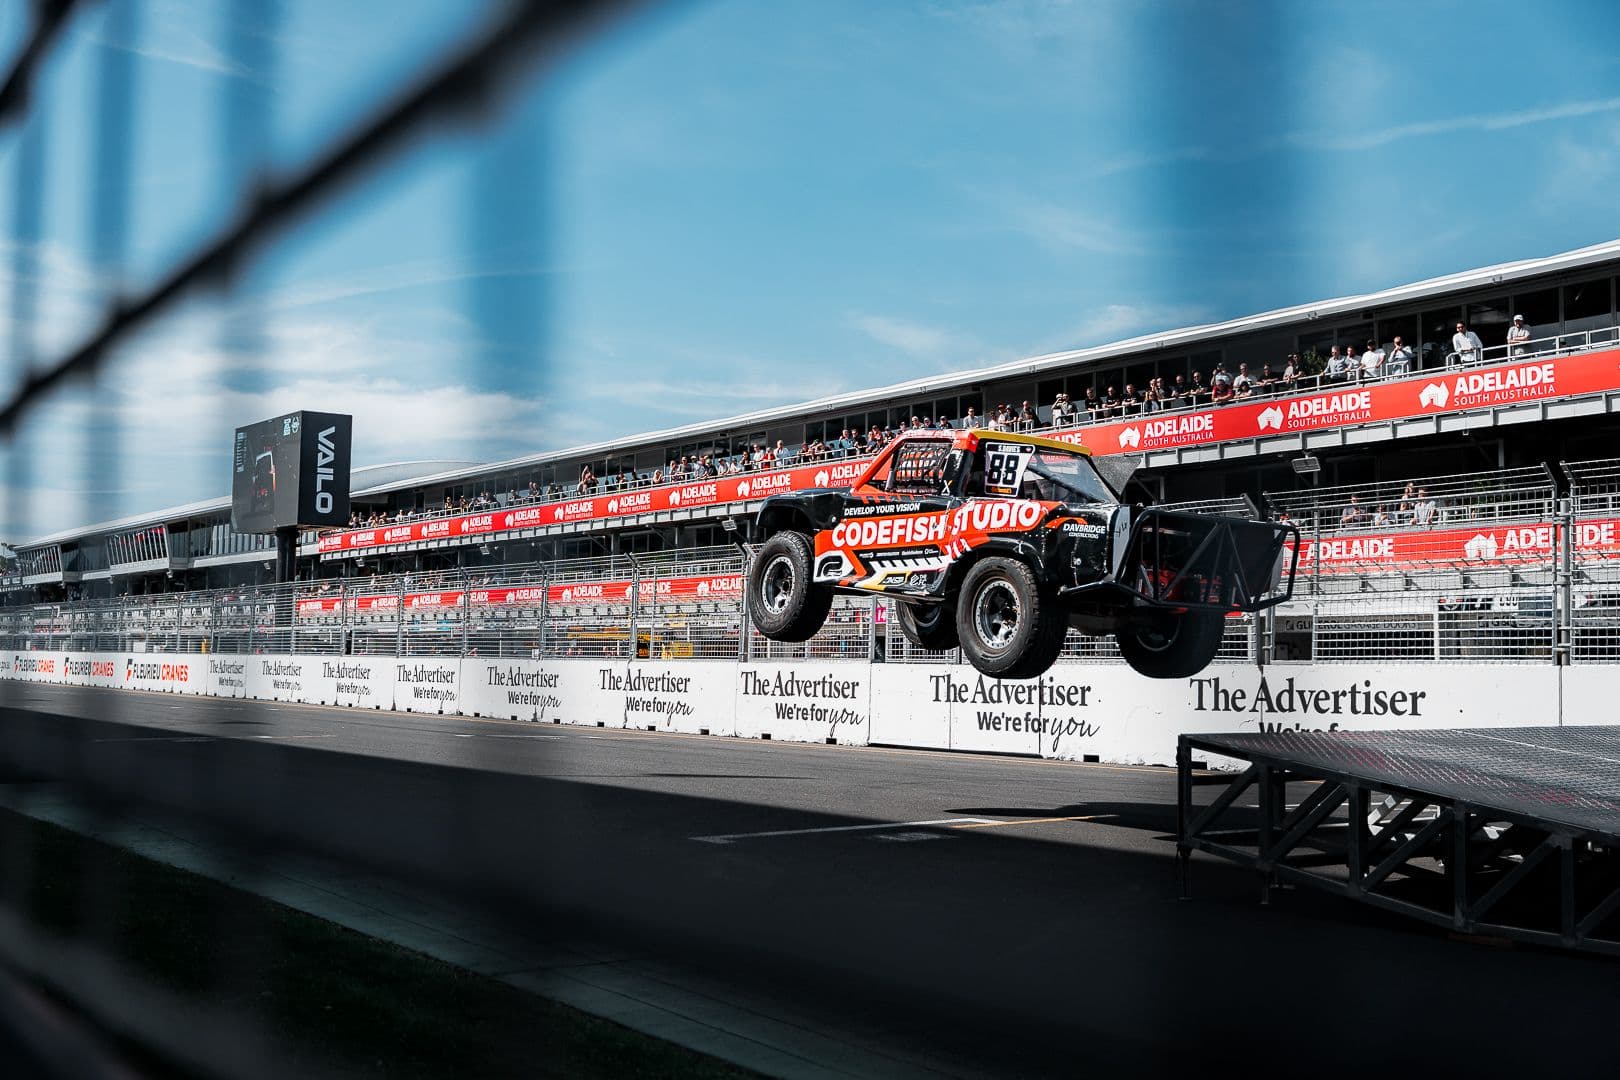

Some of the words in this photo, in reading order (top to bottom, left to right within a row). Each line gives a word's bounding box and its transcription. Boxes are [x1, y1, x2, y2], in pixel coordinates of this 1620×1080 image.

[1454, 363, 1555, 395] ADELAIDE
[1288, 391, 1371, 419] ADELAIDE
[1454, 395, 1490, 407] SOUTH
[1494, 385, 1556, 401] AUSTRALIA
[1144, 414, 1213, 438] ADELAIDE
[1288, 416, 1318, 428] SOUTH
[1321, 410, 1371, 424] AUSTRALIA
[1144, 438, 1168, 448] SOUTH
[1171, 431, 1213, 444] AUSTRALIA
[315, 426, 336, 514] VAILO
[988, 454, 1019, 485] 88
[682, 484, 716, 499] ADELAIDE
[752, 474, 791, 490] ADELAIDE
[565, 501, 593, 514] ADELAIDE
[620, 493, 650, 507] ADELAIDE
[844, 505, 875, 516] DEVELOP
[876, 504, 894, 514] YOUR
[895, 502, 920, 513] VISION
[469, 515, 492, 527] ADELAIDE
[515, 508, 540, 521] ADELAIDE
[832, 515, 947, 548] CODEFISH
[952, 500, 1041, 536] STUDIO
[1306, 538, 1394, 560] ADELAIDE
[573, 585, 602, 597] ADELAIDE
[92, 662, 114, 677] CRANES
[134, 663, 161, 679] FLEURIEU
[161, 664, 189, 682] CRANES
[263, 661, 274, 675] The
[274, 661, 302, 676] Advertiser
[323, 662, 335, 678] The
[335, 662, 370, 679] Advertiser
[397, 664, 412, 682] The
[413, 665, 455, 683] Advertiser
[487, 666, 505, 686] The
[506, 668, 559, 688] Advertiser
[600, 669, 622, 691] The
[623, 670, 690, 693] Advertiser
[741, 671, 770, 697] The
[770, 671, 859, 699] Advertiser
[930, 674, 968, 703] The
[973, 675, 1091, 706] Advertiser
[414, 686, 430, 699] We're
[430, 687, 440, 699] for
[1190, 677, 1246, 712] The
[1249, 676, 1426, 717] Advertiser
[508, 691, 528, 704] We're
[529, 692, 541, 705] for
[541, 696, 562, 719] you
[626, 697, 651, 711] We're
[652, 698, 666, 712] for
[667, 702, 694, 727] you
[775, 703, 808, 720] We're
[810, 704, 828, 722] for
[828, 710, 864, 737] you
[977, 711, 1021, 732] We're
[1024, 713, 1050, 734] for
[1050, 718, 1100, 752] you
